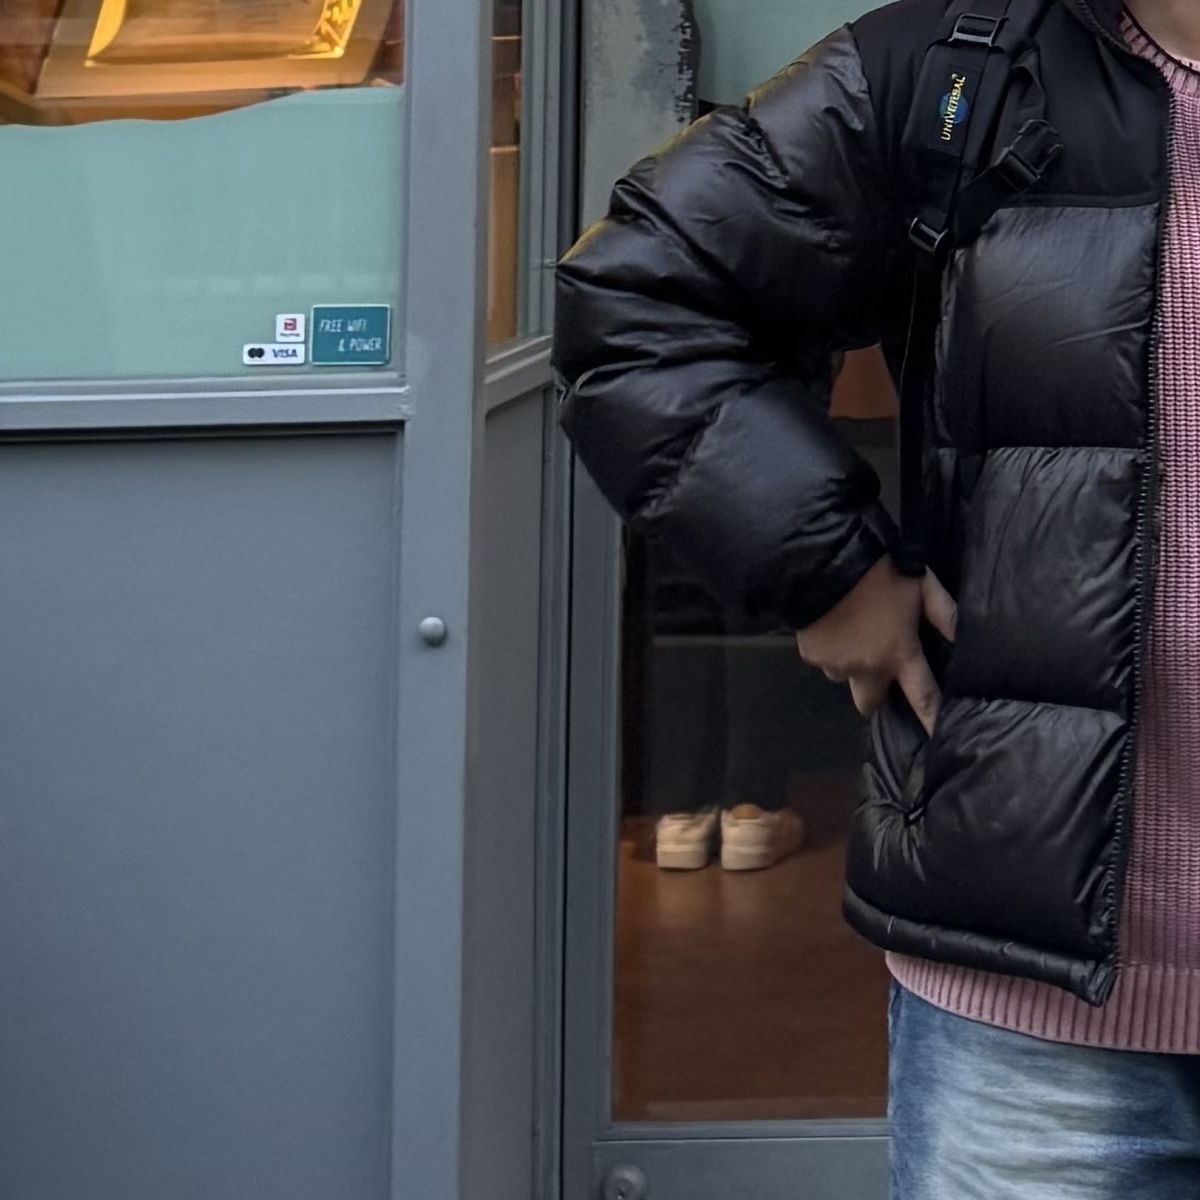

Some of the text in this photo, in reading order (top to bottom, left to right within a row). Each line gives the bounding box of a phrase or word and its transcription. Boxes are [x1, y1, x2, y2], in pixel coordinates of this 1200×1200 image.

[941, 76, 966, 141] UNIVERSAL
[318, 319, 342, 333] FREE
[349, 337, 382, 352] POWER
[271, 348, 298, 359] VISA
